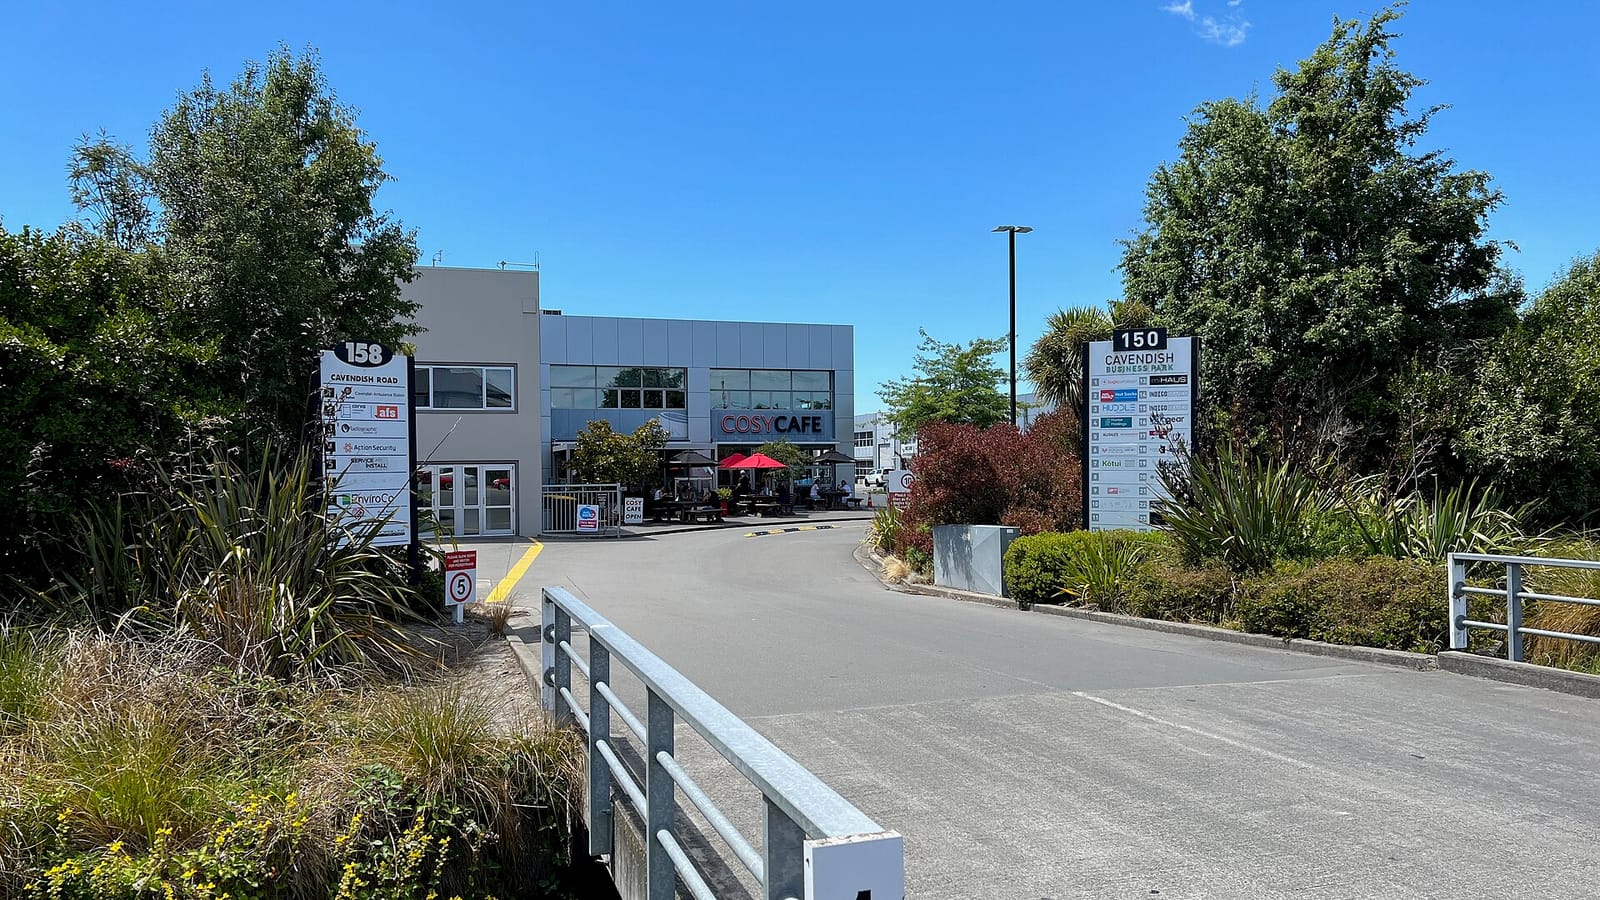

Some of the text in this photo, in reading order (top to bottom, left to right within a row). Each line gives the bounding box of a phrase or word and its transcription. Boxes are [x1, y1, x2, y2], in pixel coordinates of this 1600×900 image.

[1122, 331, 1158, 348] 150
[346, 342, 382, 364] 158
[1105, 352, 1174, 365] CAVENDISH
[1106, 364, 1174, 373] BUSINESS PARK
[330, 374, 374, 383] CAVENDISH
[457, 579, 465, 595] 5
